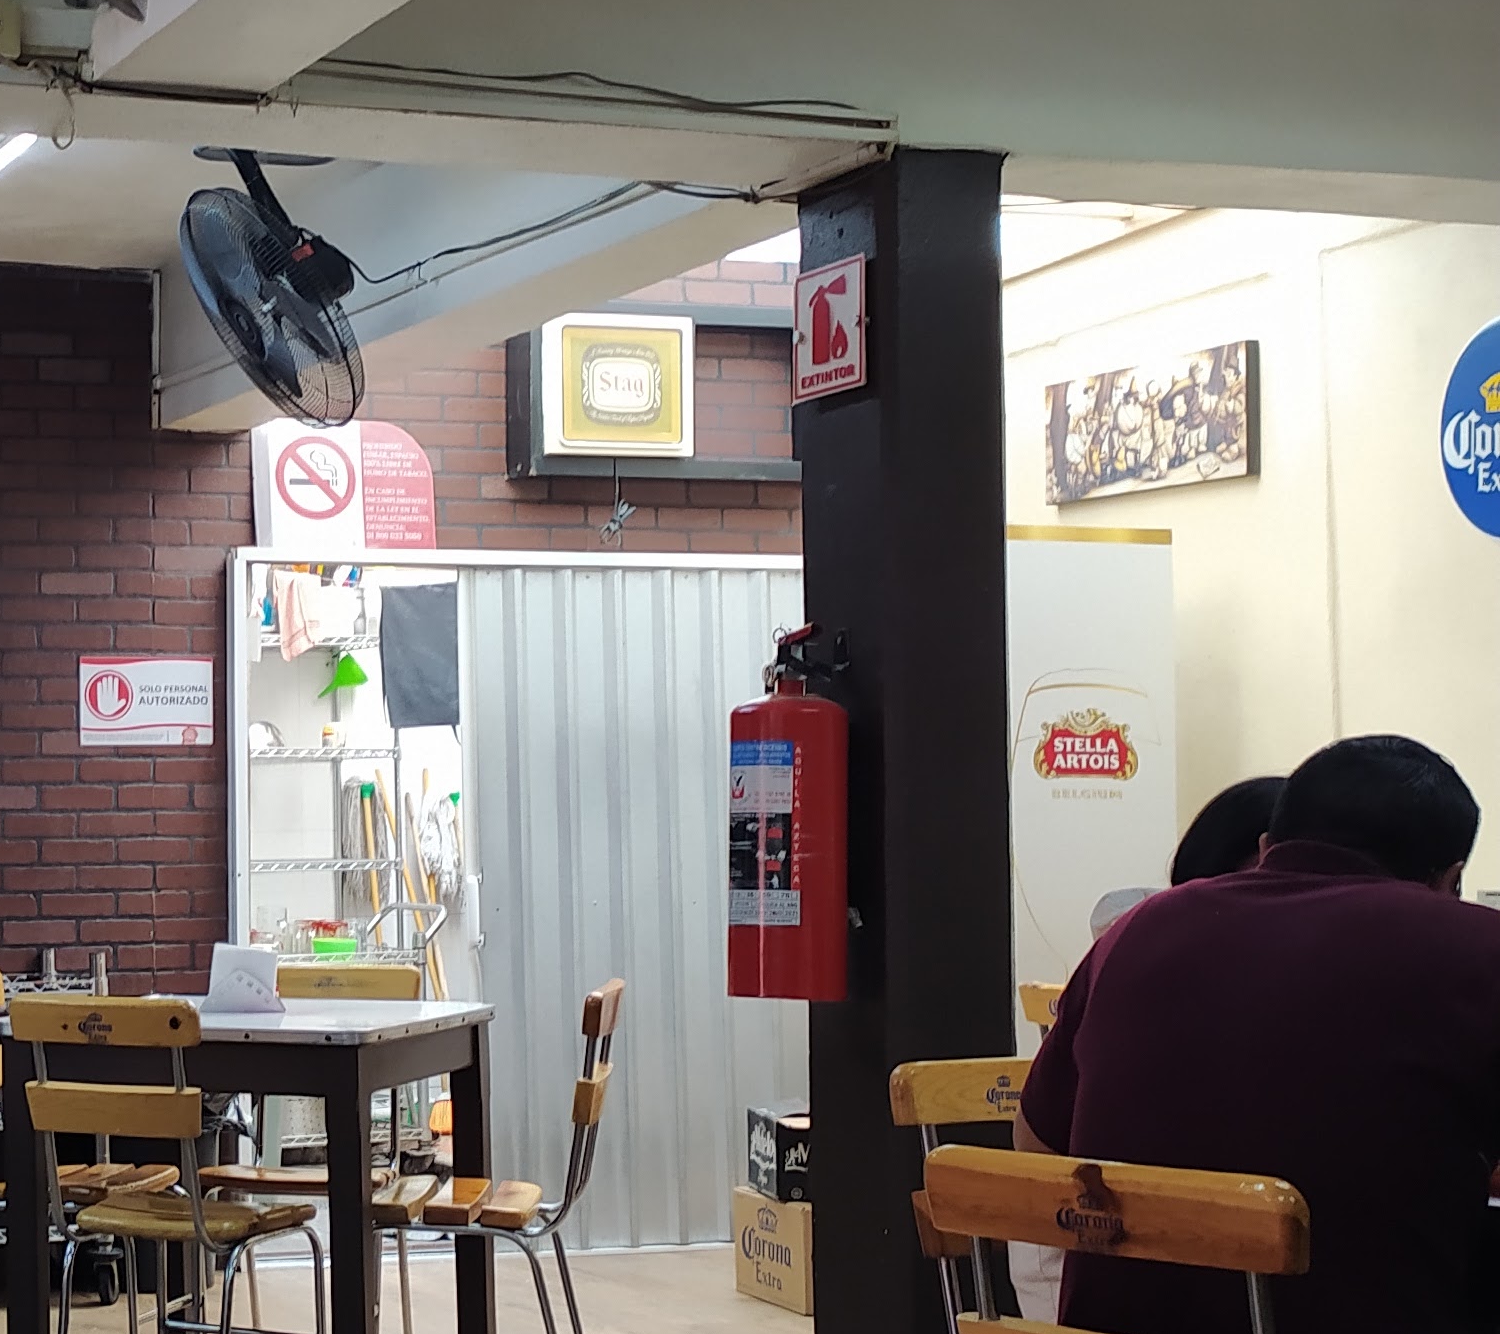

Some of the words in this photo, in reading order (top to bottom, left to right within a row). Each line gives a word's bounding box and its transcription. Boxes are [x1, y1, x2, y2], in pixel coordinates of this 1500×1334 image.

[600, 370, 645, 399] Stag
[801, 363, 856, 390] EXTINTOR
[139, 684, 162, 693] SOLO
[164, 684, 209, 693] PERSONAL
[138, 695, 209, 706] AUTORIZADO
[1053, 736, 1119, 753] STELLA
[1052, 753, 1120, 770] ARTOIS
[741, 1226, 792, 1269] Corona
[756, 1261, 782, 1291] Extra
